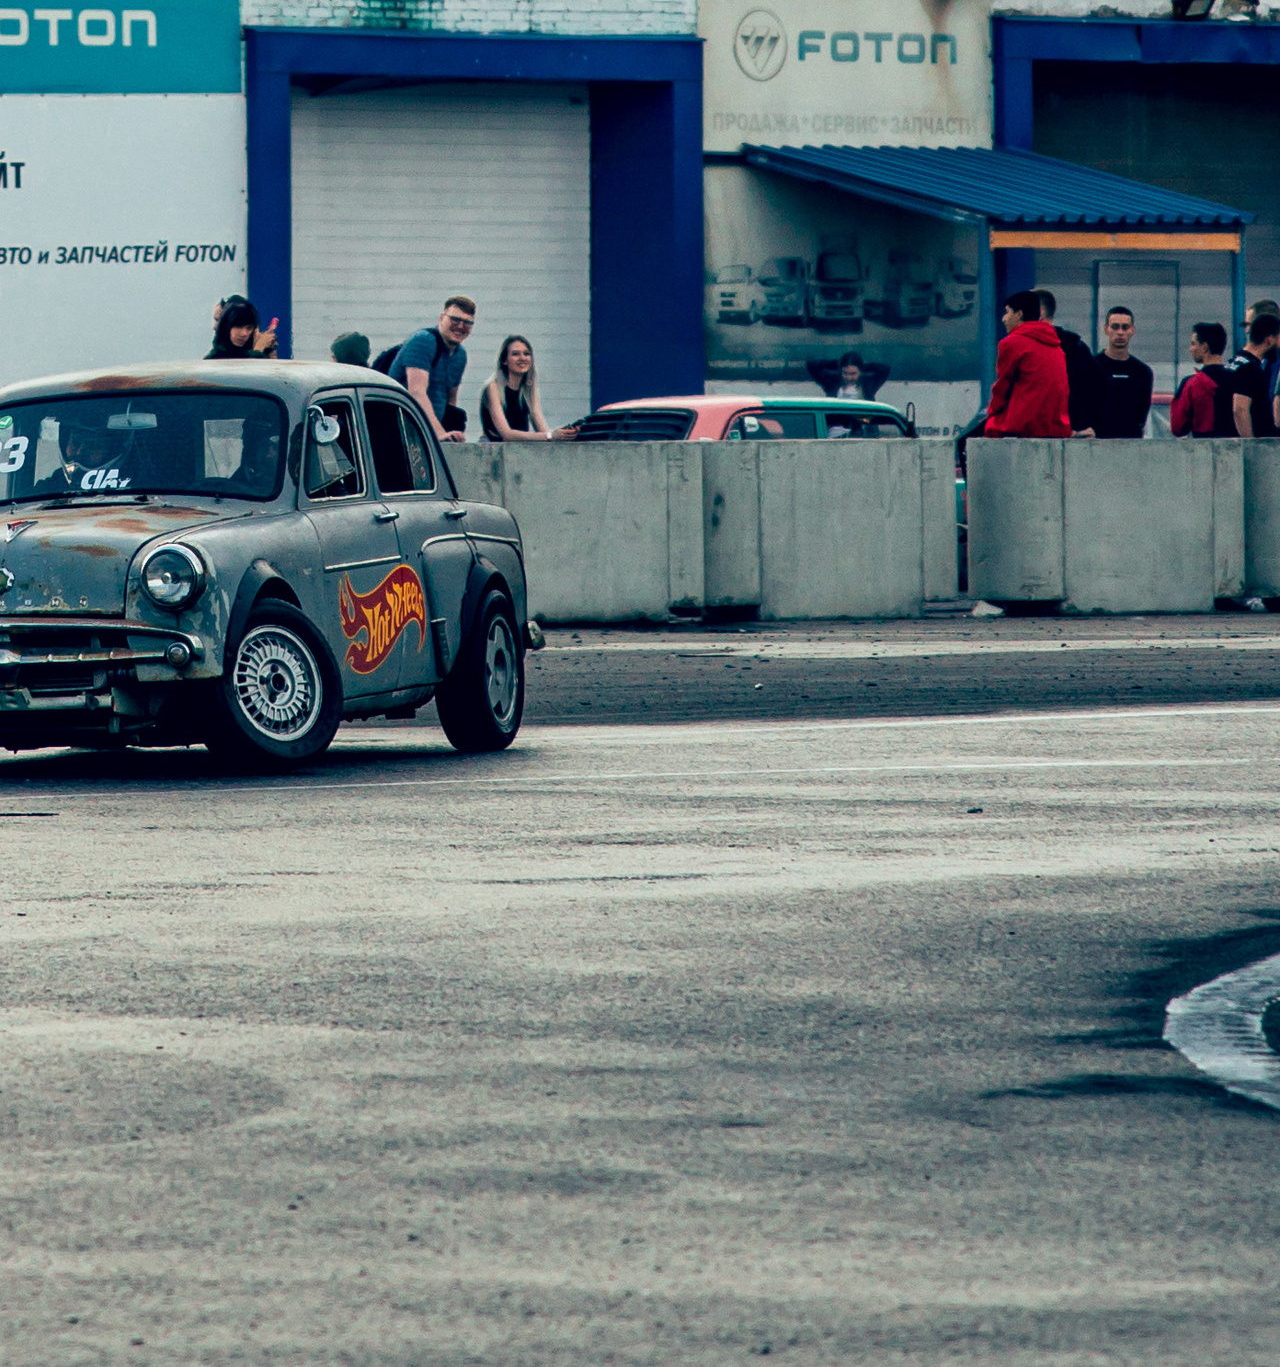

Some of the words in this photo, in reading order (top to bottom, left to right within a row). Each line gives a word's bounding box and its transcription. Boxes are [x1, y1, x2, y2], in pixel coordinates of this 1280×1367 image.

[797, 29, 958, 65] FOTON
[37, 250, 50, 264] и
[54, 240, 169, 264] ЗАПЧАСТЕЙ
[174, 244, 237, 263] FOTON
[360, 601, 390, 662] Hot
